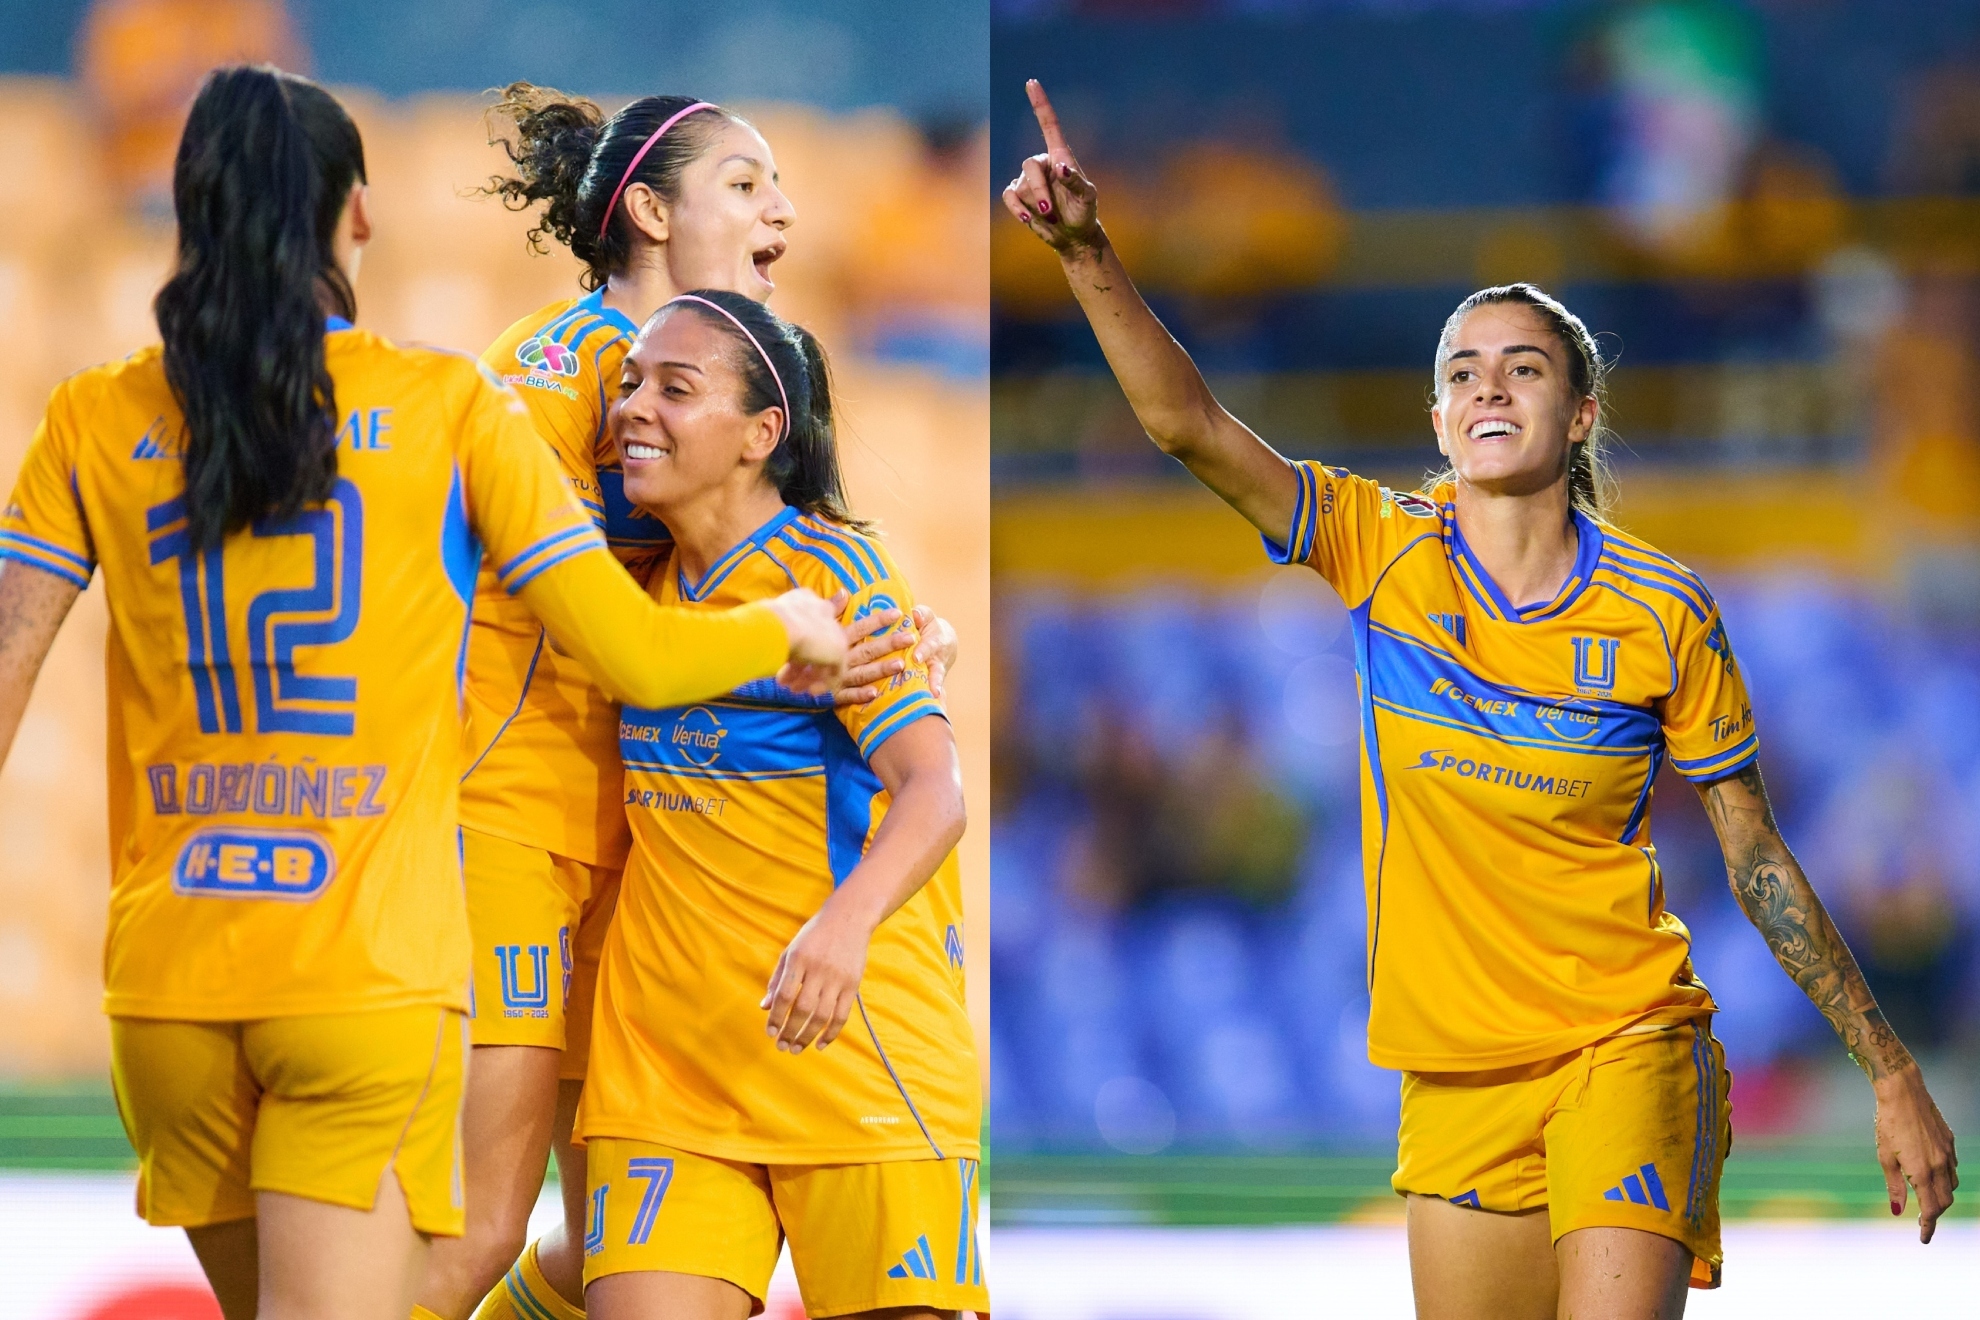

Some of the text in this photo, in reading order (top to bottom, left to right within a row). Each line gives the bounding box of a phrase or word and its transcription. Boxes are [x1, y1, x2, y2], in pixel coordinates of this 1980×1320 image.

[526, 376, 562, 392] BBVA
[146, 478, 364, 736] 12
[1571, 637, 1620, 690] U
[1449, 687, 1519, 717] CEMEX
[620, 724, 720, 749] CEMEX Vertua
[1708, 714, 1740, 742] Tim
[1403, 749, 1592, 798] SPORTIUMBET
[494, 945, 549, 1008] U
[626, 1157, 674, 1245] 7
